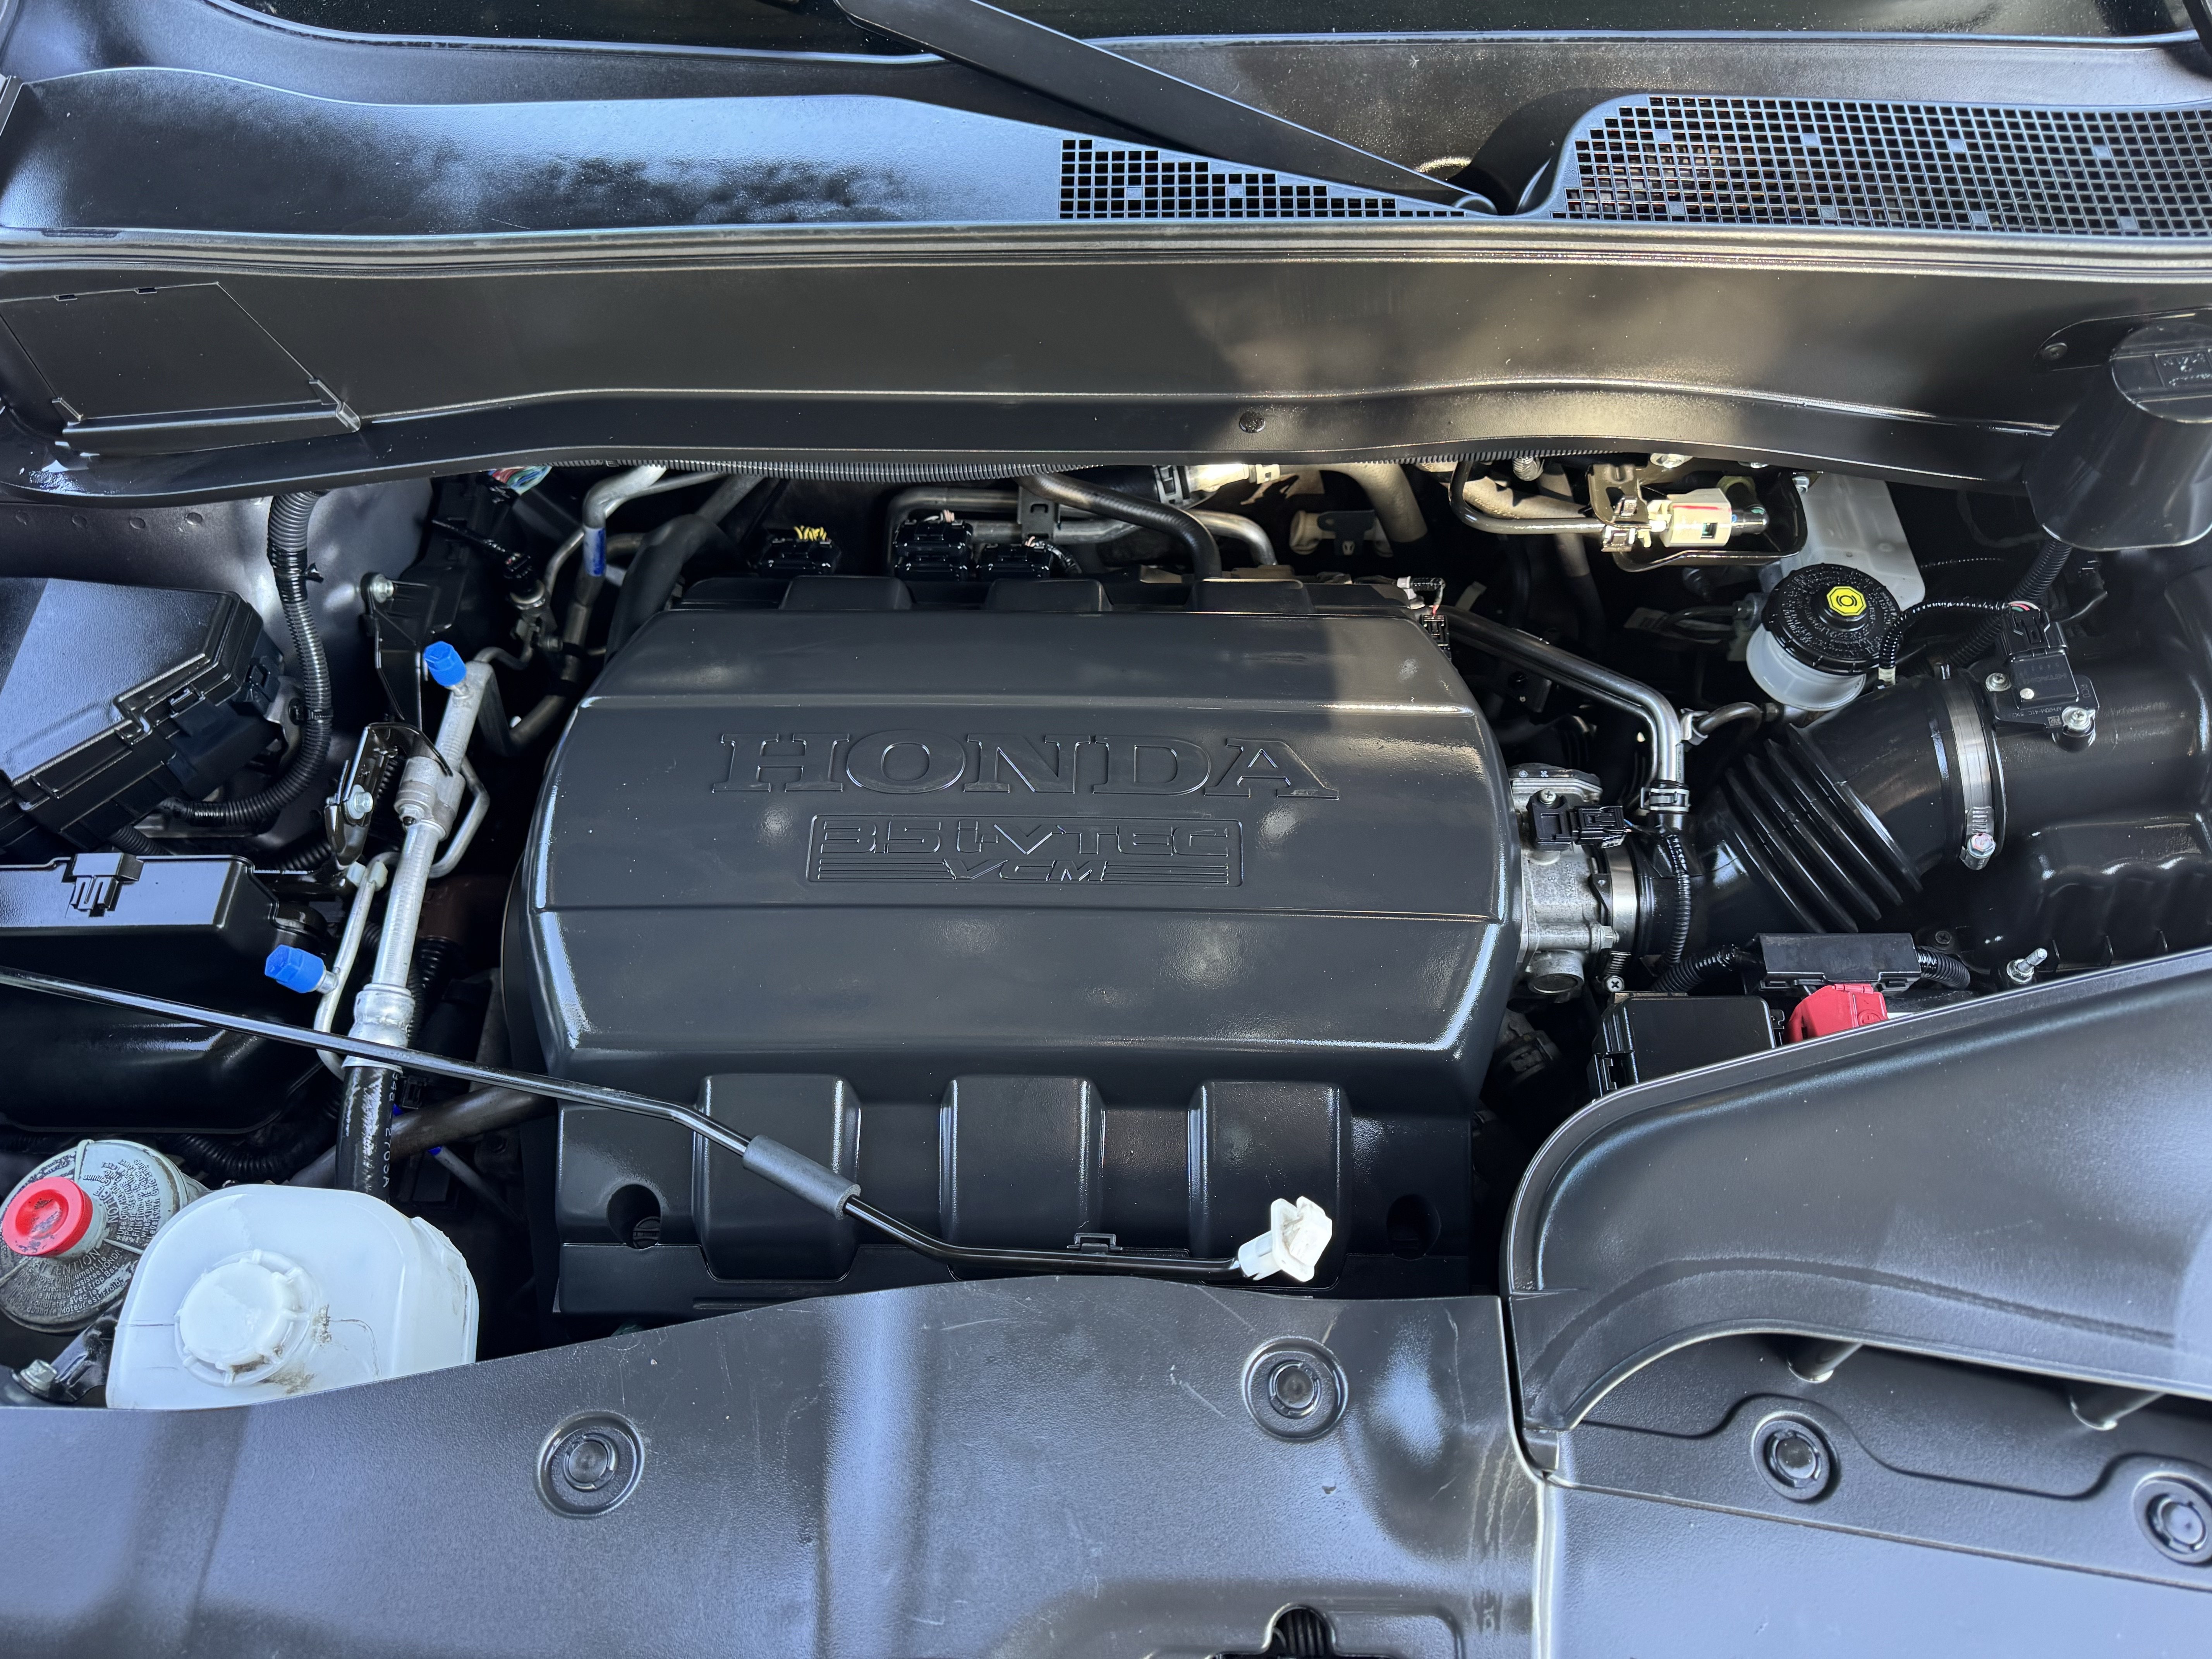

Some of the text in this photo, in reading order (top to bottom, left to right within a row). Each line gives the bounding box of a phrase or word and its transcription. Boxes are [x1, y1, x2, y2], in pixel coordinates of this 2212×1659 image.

[712, 729, 1340, 800] HONDA
[943, 857, 1109, 882] VCM
[83, 1174, 111, 1186] Genuine
[148, 1178, 159, 1196] Cold
[109, 1183, 126, 1204] HONDA
[120, 1181, 135, 1209] Steering
[93, 1185, 119, 1223] NOTICE
[120, 1204, 129, 1220] Only
[124, 1214, 136, 1236] Power
[141, 1217, 151, 1237] when
[74, 1286, 86, 1295] est
[88, 1276, 105, 1289] trop
[88, 1294, 101, 1305] est
